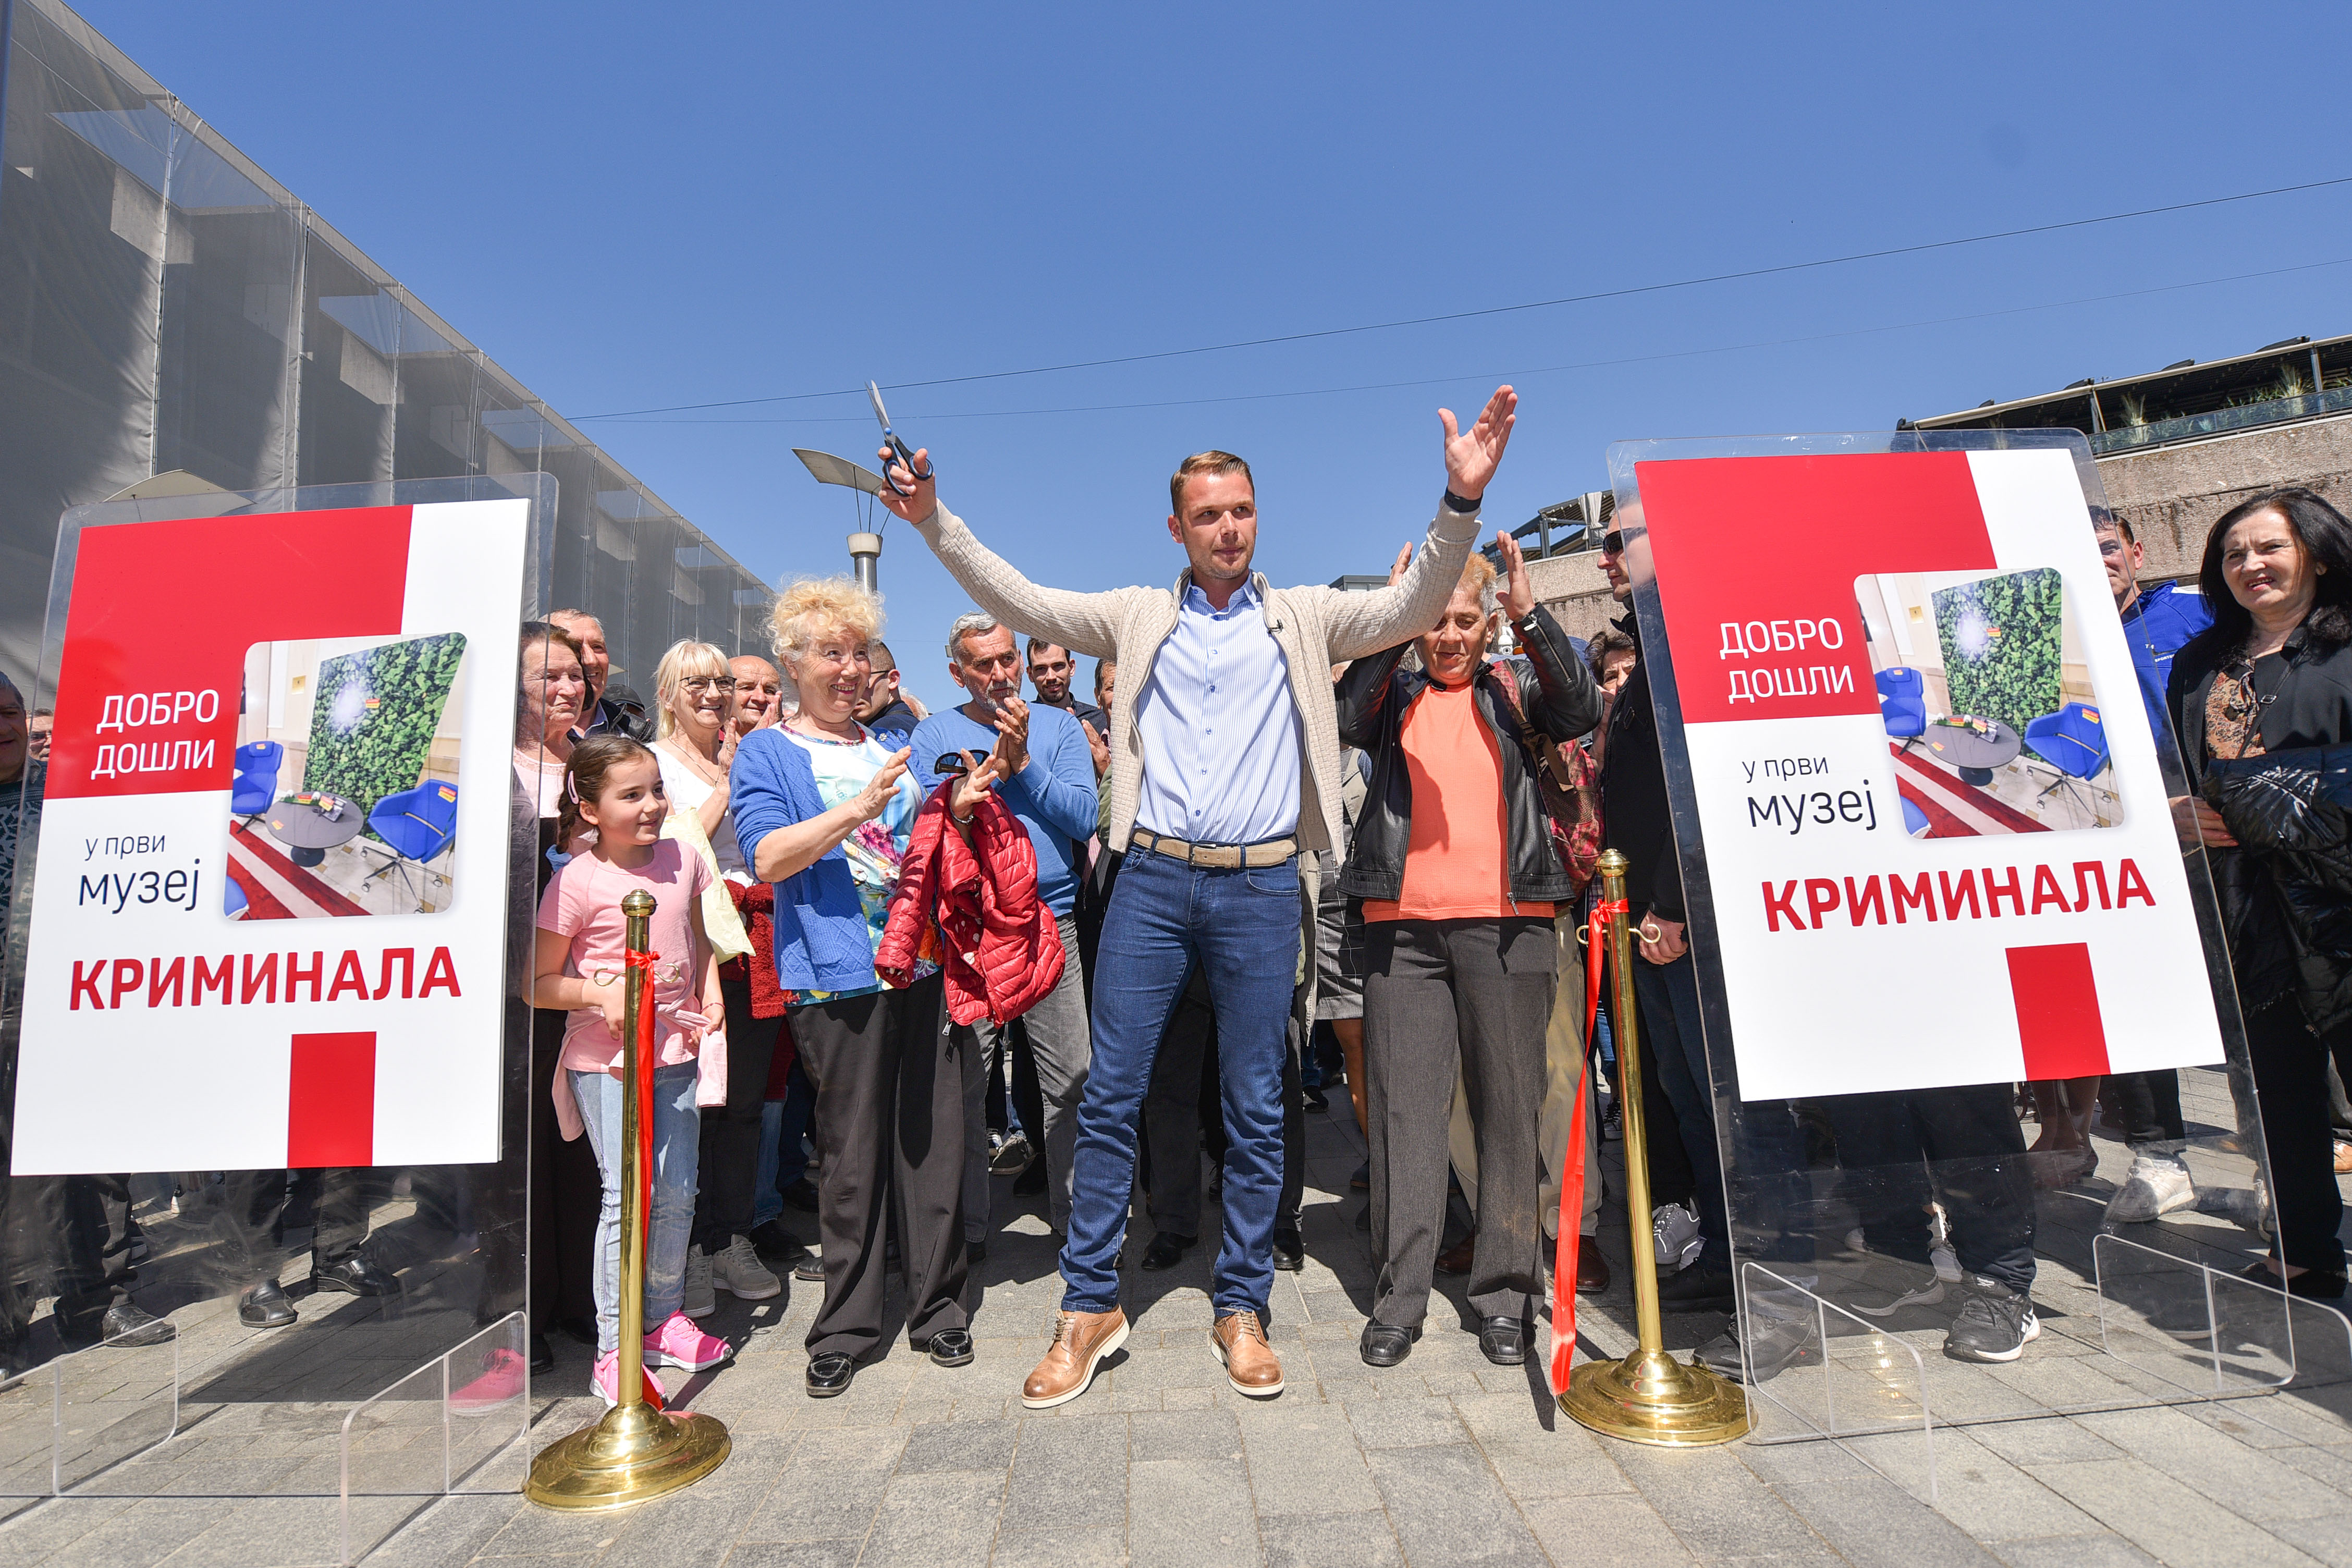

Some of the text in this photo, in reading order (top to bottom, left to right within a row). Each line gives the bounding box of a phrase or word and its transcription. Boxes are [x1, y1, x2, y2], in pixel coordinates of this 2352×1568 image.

[1719, 617, 1844, 660] ДОБРО
[1728, 665, 1855, 705] ДОШЛИ
[95, 689, 219, 735] ДОБРО
[90, 739, 215, 781] ДОШЛИ
[1742, 756, 1829, 783] у први
[1747, 779, 1877, 836] музеј
[84, 835, 165, 862] у први
[78, 858, 201, 915] музеј
[1761, 858, 2157, 933] КРИМИНАЛА
[70, 946, 462, 1011] КРИМИНАЛА
